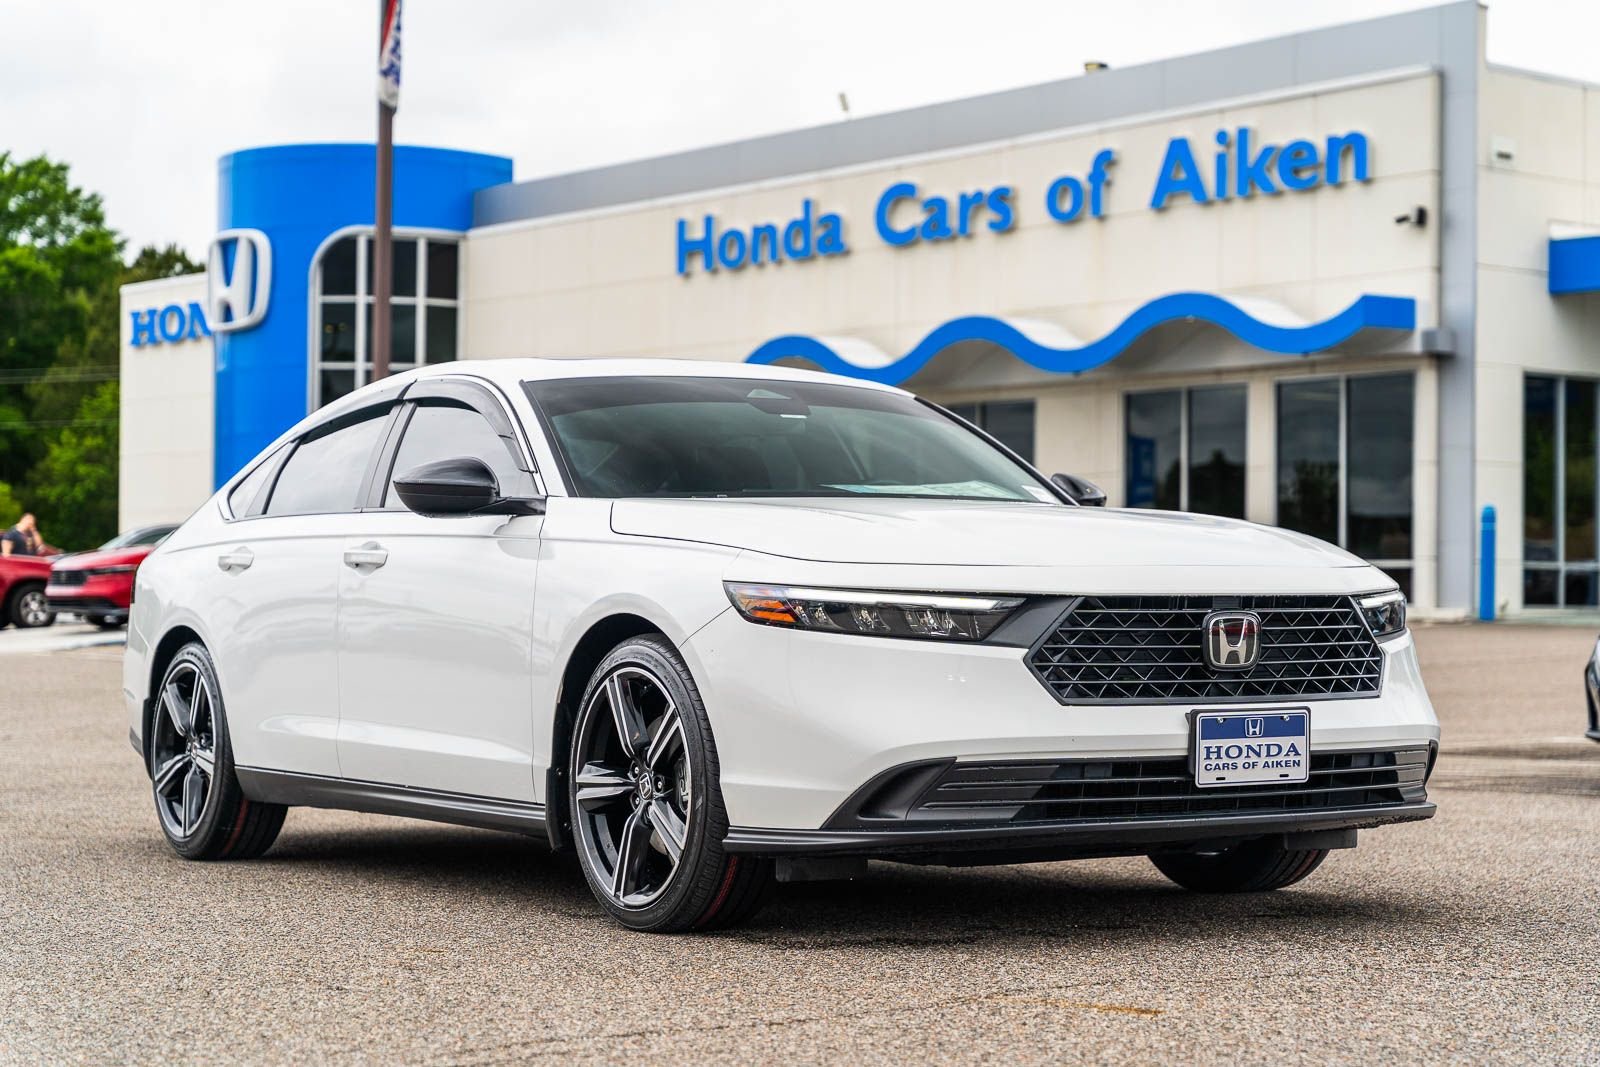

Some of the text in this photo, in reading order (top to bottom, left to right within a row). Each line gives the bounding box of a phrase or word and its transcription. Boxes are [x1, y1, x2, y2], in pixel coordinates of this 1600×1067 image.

[676, 126, 1369, 276] Honda Cars of Aiken
[1203, 742, 1302, 760] HONDA
[1204, 759, 1301, 772] CARS OF AIKEN
